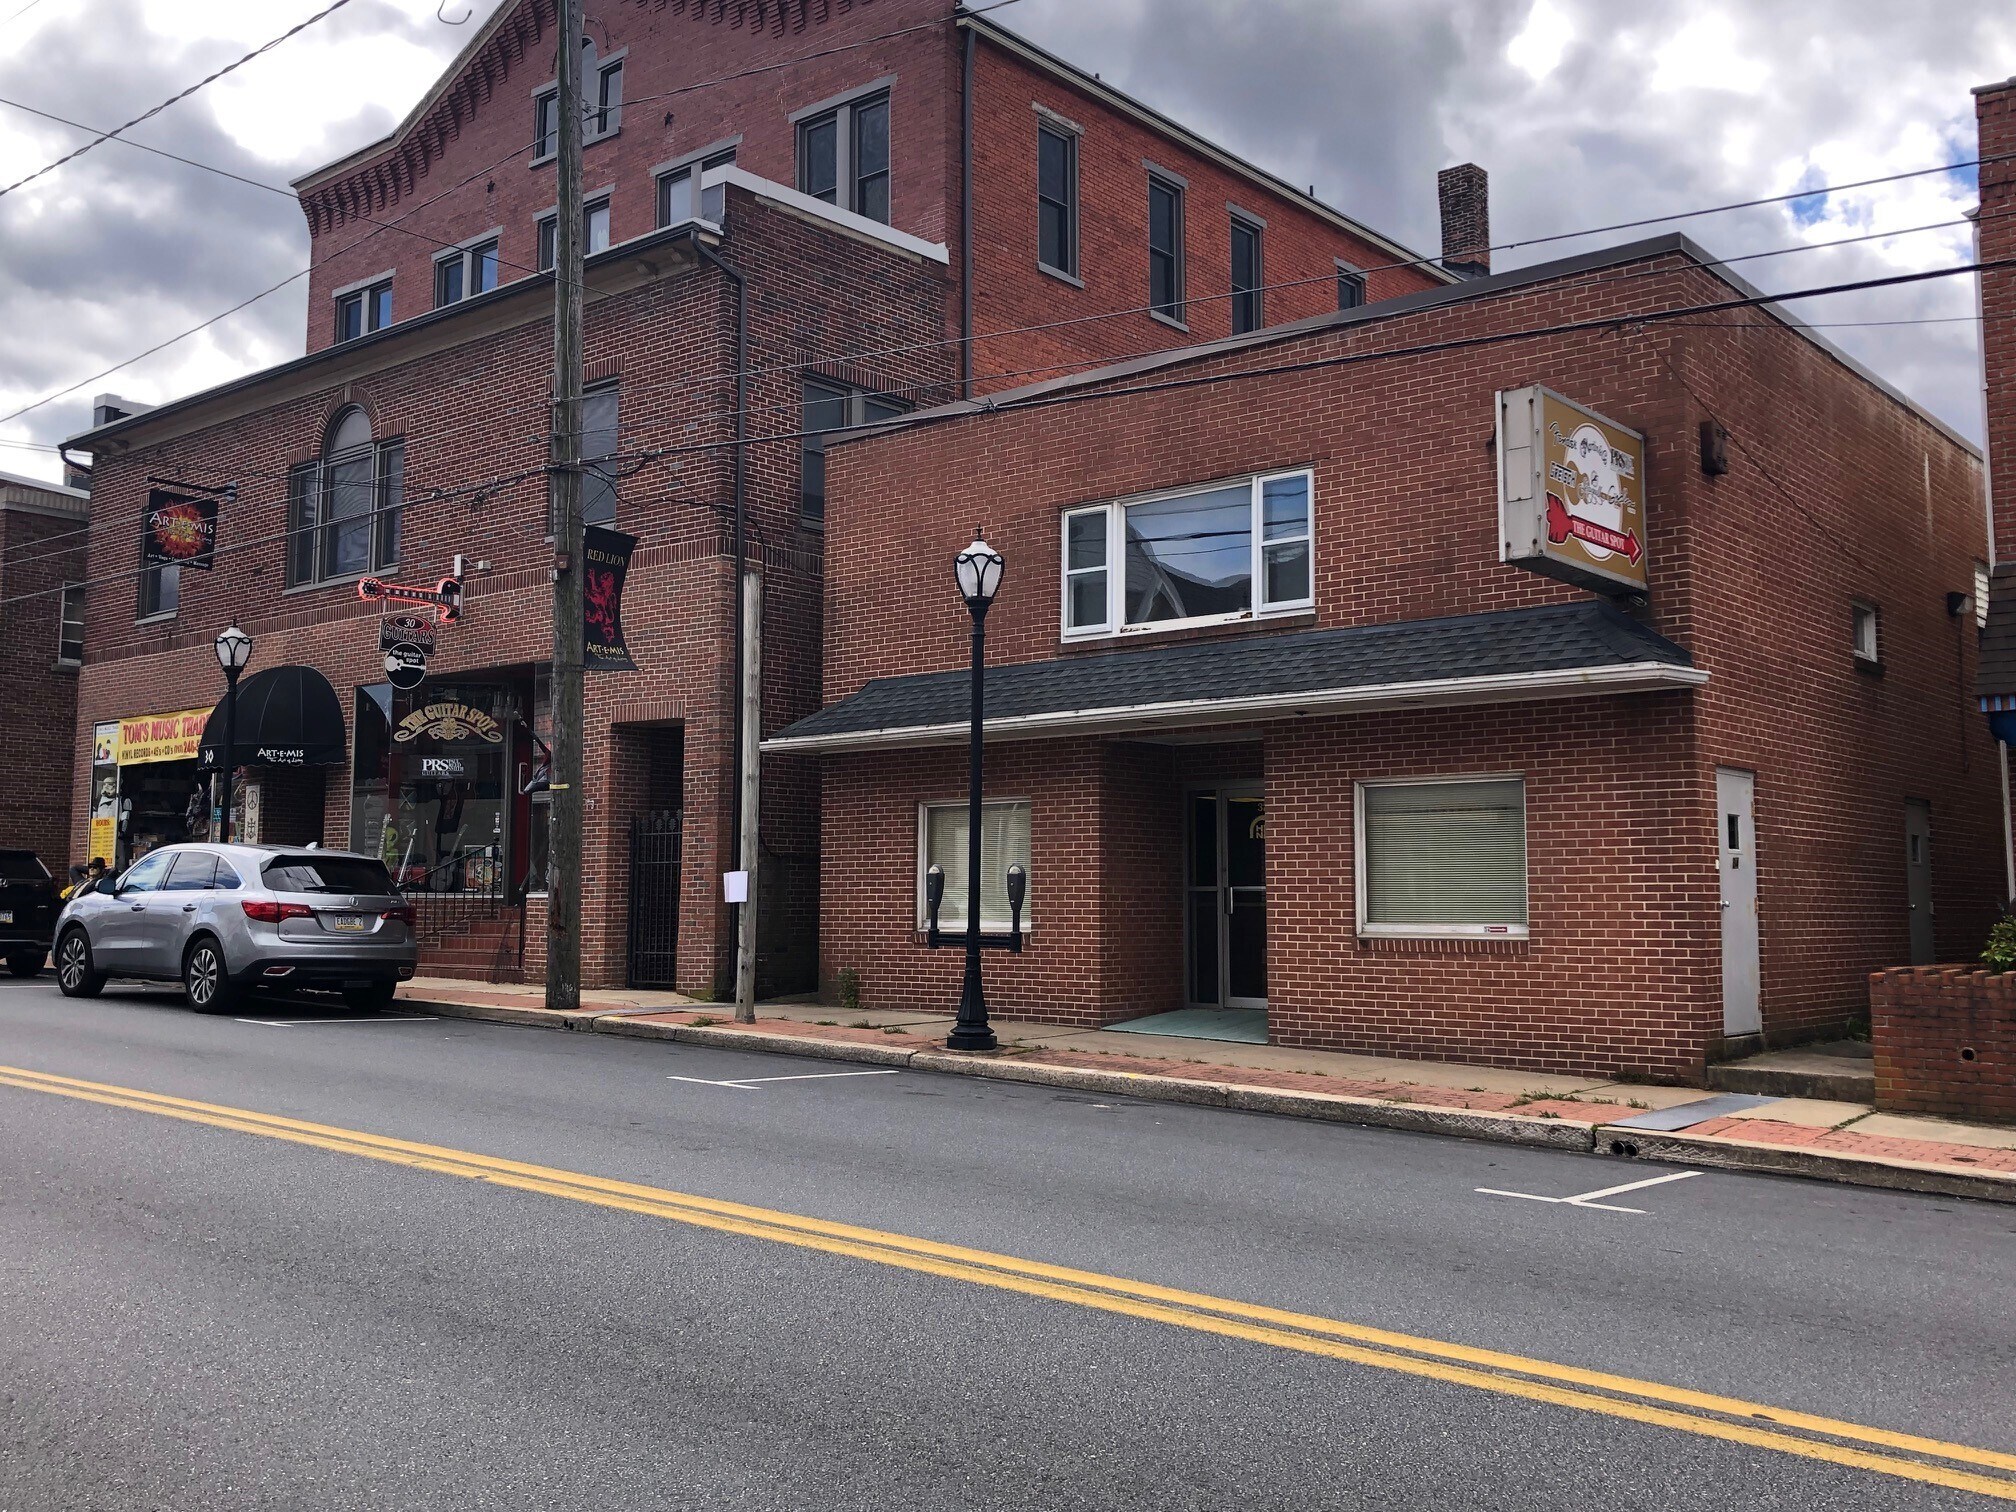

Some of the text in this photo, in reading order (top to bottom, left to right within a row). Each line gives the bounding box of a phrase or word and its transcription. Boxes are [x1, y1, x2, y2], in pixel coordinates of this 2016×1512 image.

[1571, 520, 1625, 551] THE GUITAR SPOT
[587, 548, 625, 566] RED LION
[404, 618, 416, 628] 30
[384, 623, 433, 644] GUITARS
[403, 651, 421, 659] guitar
[399, 702, 499, 732] THE GUITAR SPOT
[123, 722, 149, 744] TOM'S
[151, 718, 179, 740] MUSIC
[133, 747, 151, 759] RECORDS
[204, 749, 214, 764] 30
[421, 758, 449, 771] PRS
